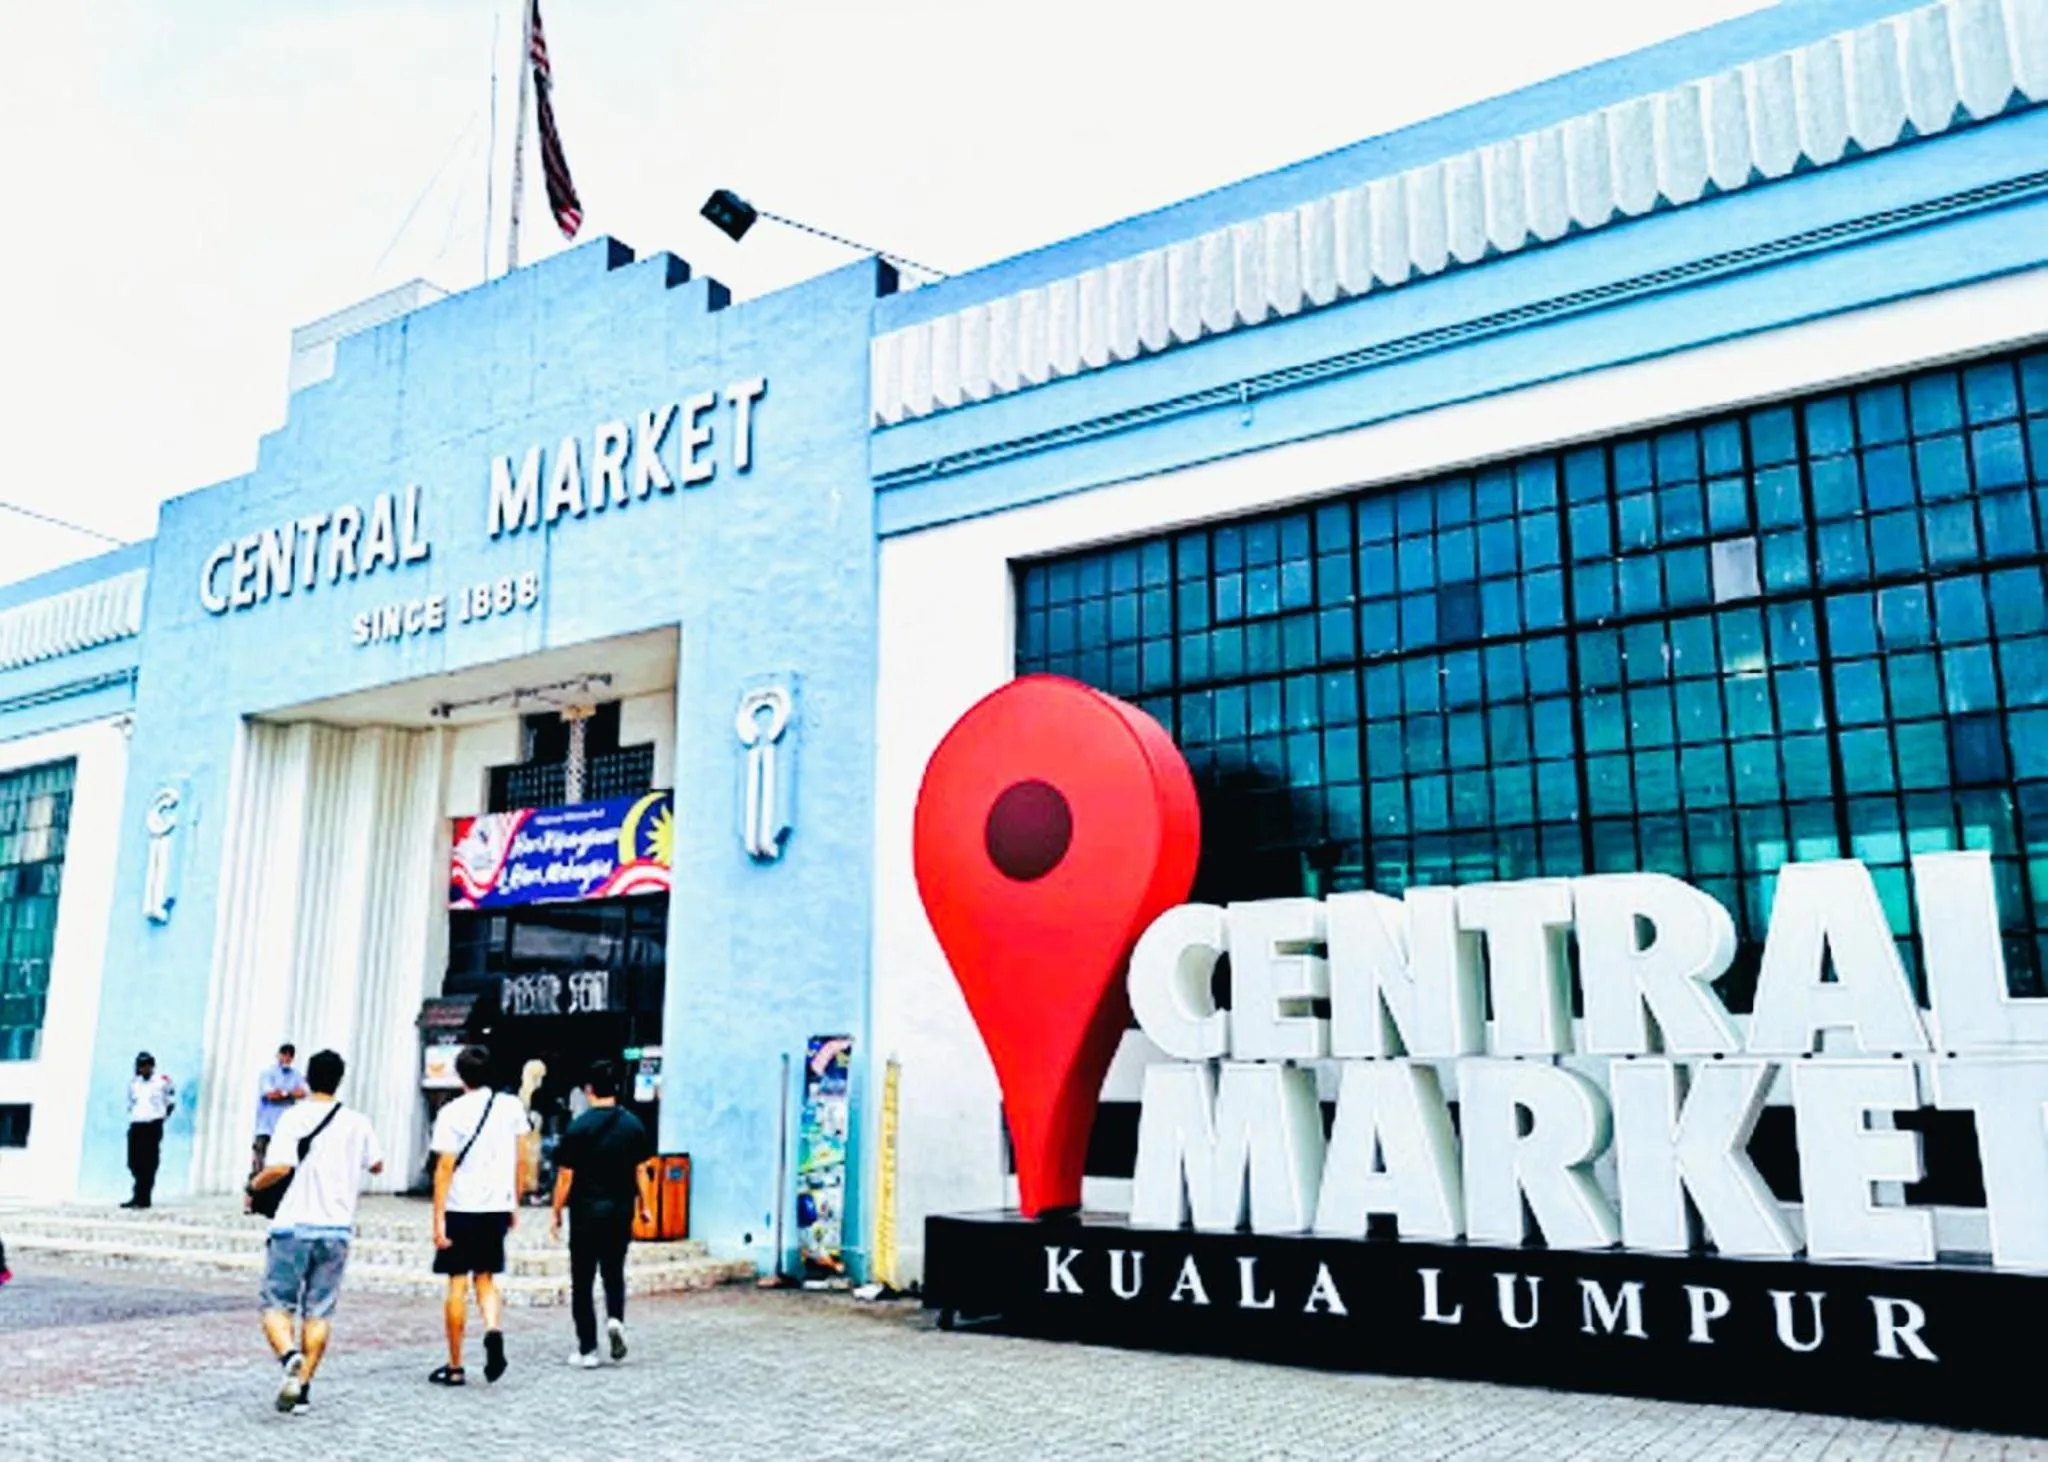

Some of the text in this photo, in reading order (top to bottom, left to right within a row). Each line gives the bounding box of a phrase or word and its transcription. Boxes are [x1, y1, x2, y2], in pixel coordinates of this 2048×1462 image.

[200, 377, 767, 614] CENTRAL MARKET
[351, 570, 539, 646] SINCE 1888
[1127, 849, 2048, 1060] CENTRAL
[1130, 1058, 2048, 1270] MARKET
[1044, 1245, 1940, 1364] KUALA LUMPUR
